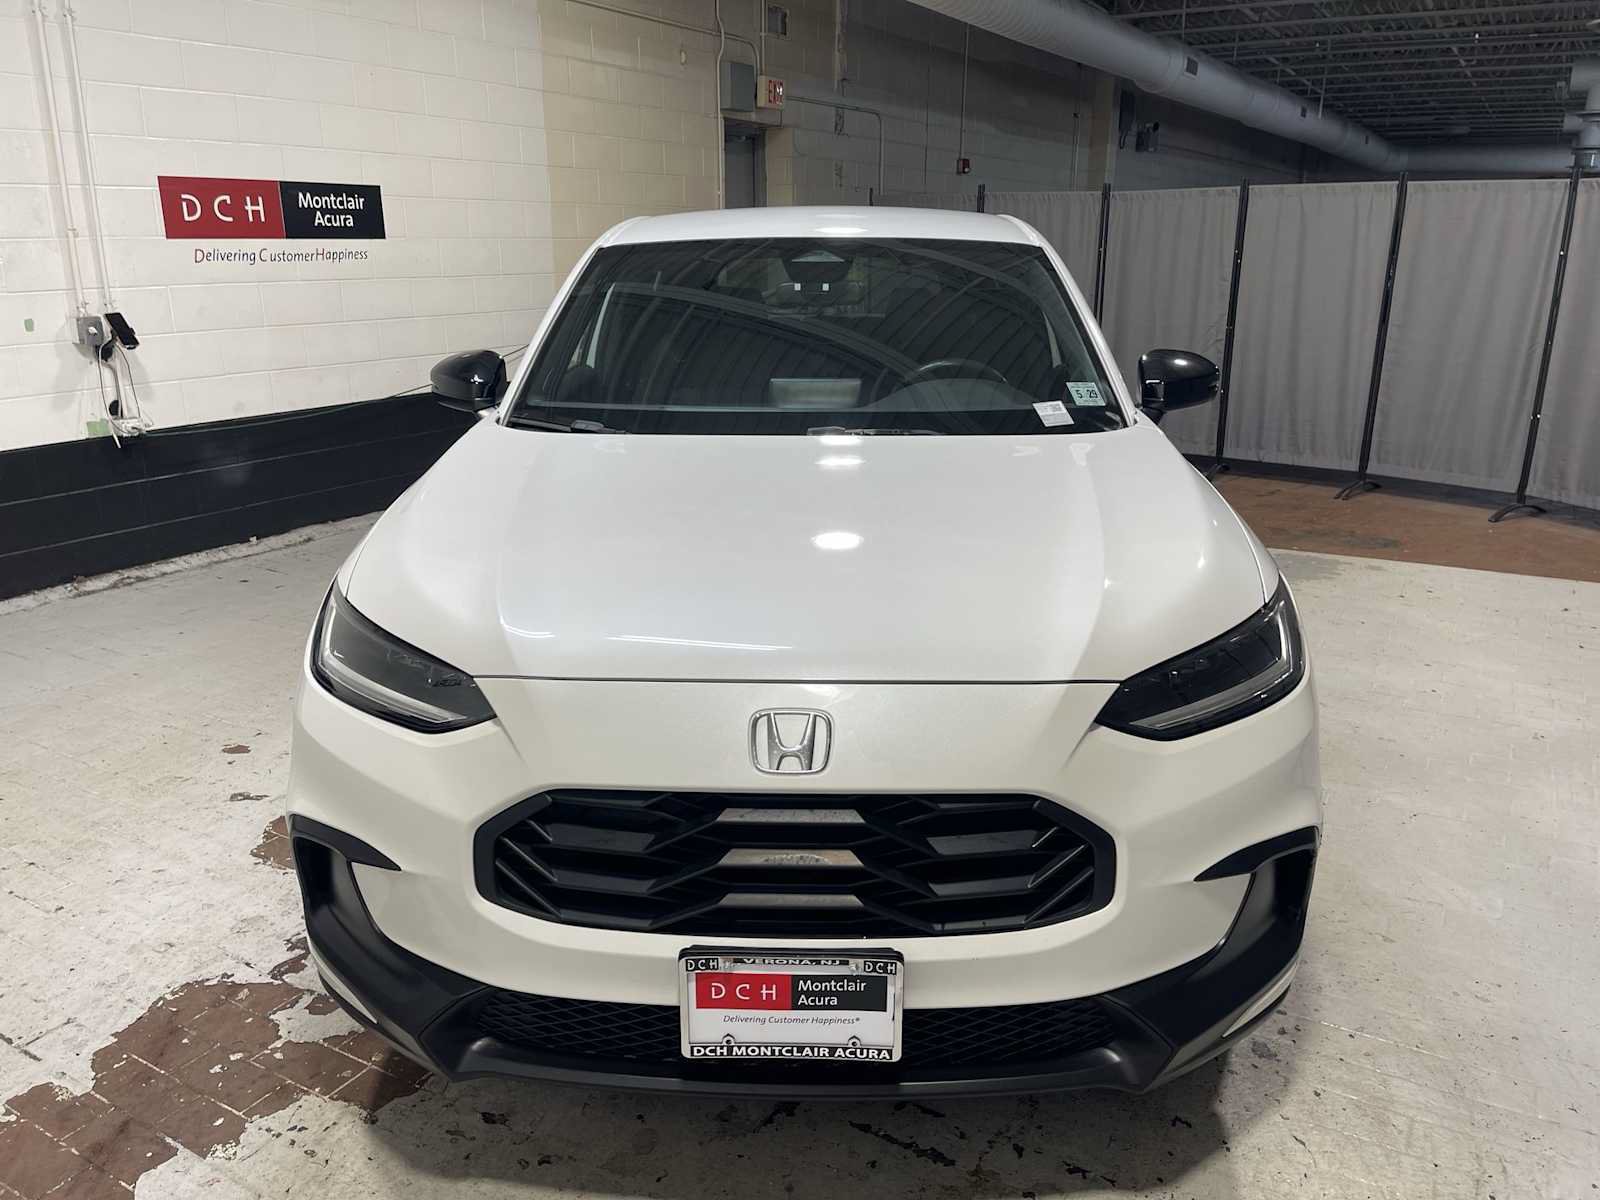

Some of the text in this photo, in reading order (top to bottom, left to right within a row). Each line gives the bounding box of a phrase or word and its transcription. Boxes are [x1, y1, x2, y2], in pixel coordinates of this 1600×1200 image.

[180, 193, 266, 223] DCH
[298, 192, 365, 211] Montclair
[314, 210, 354, 228] Acura
[194, 248, 256, 266] Delivering
[687, 959, 718, 971] DCH
[865, 961, 896, 974] DCH
[711, 982, 777, 1001] DCH
[797, 979, 867, 992] Montclair
[797, 994, 838, 1006] Acura
[723, 1015, 766, 1025] Delivering
[768, 1016, 810, 1024] Customer
[693, 1046, 891, 1060] DCH MONTCLAIR ACURA
